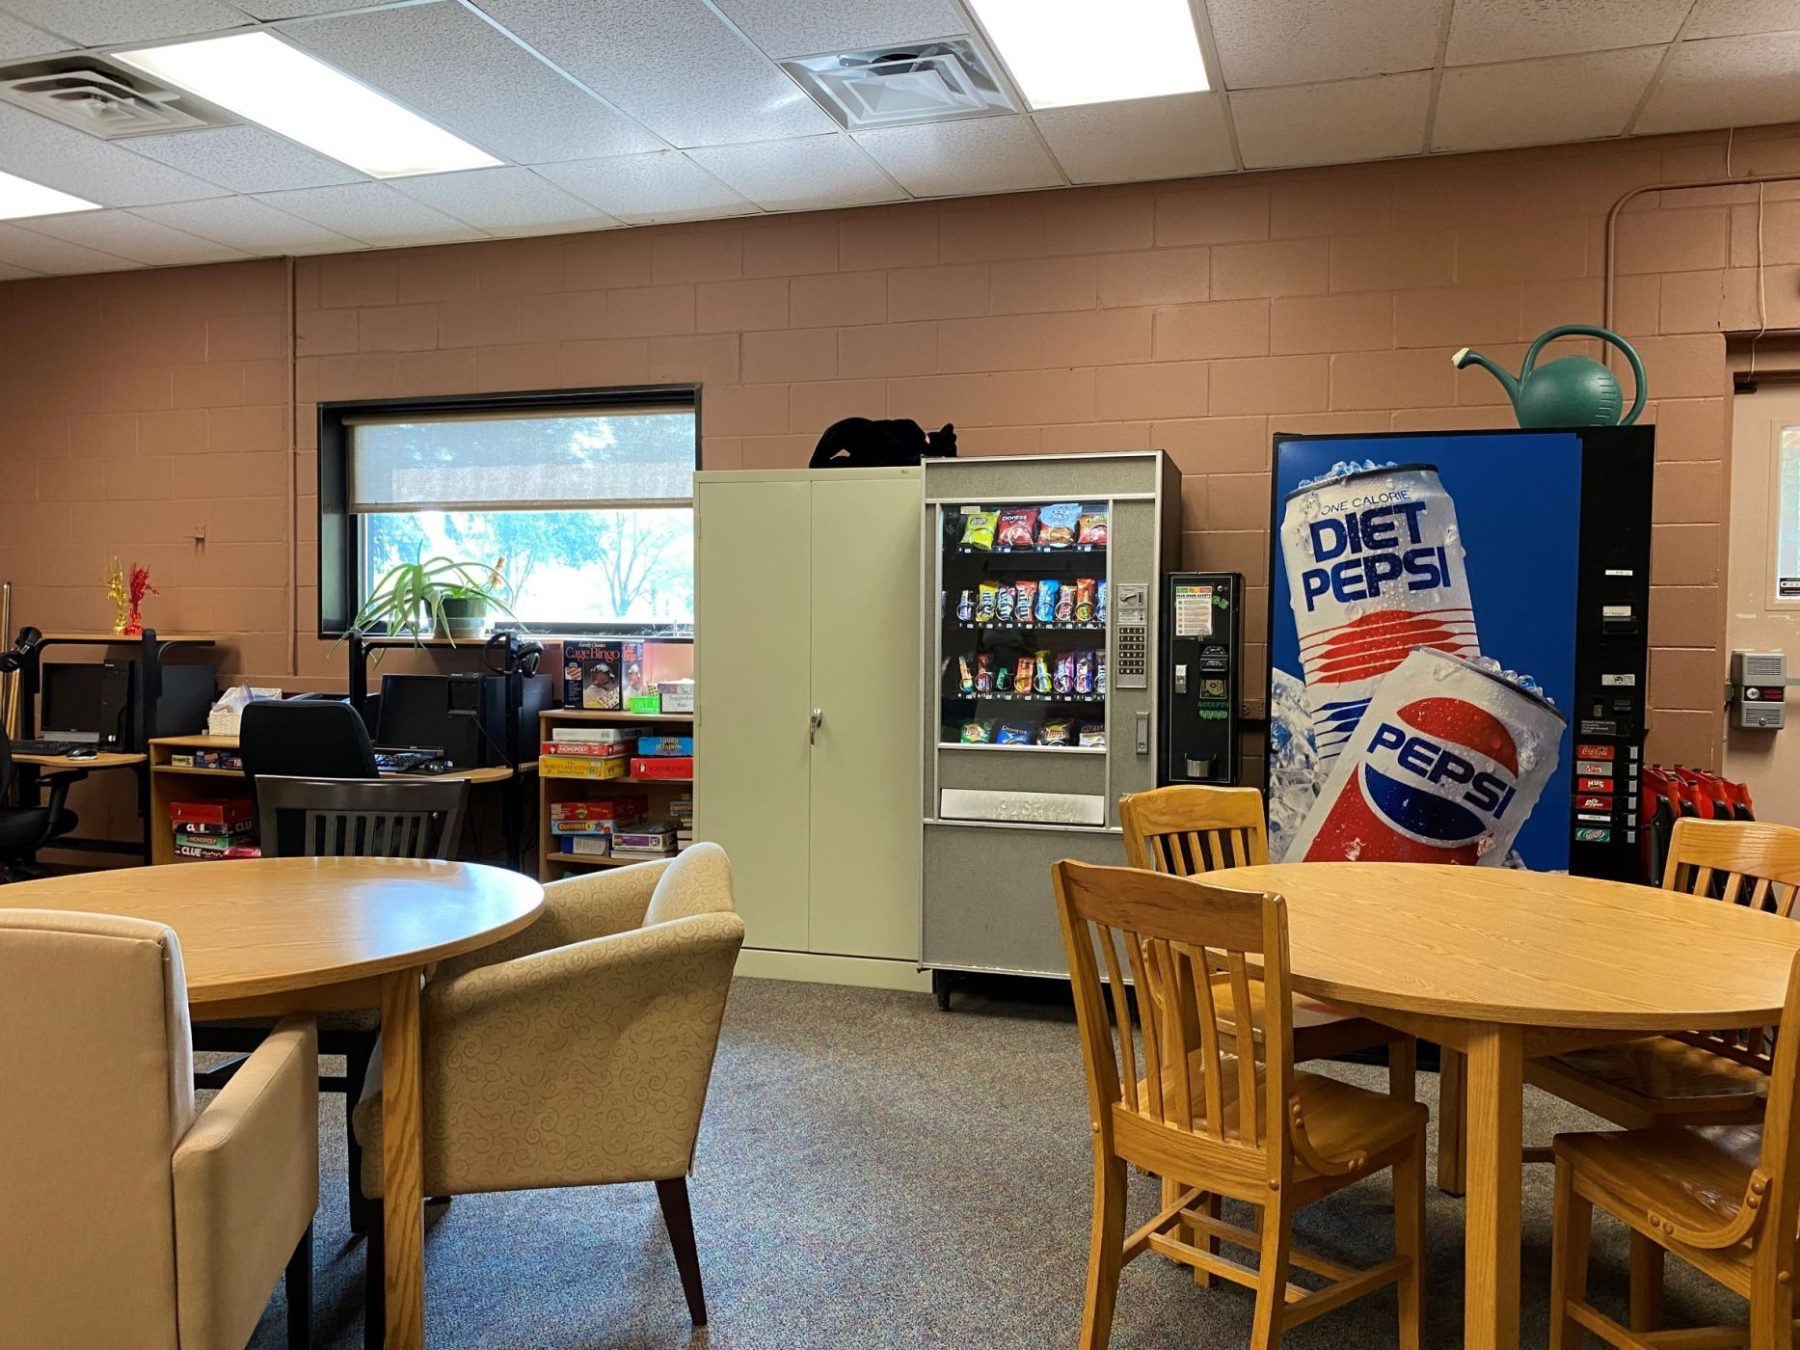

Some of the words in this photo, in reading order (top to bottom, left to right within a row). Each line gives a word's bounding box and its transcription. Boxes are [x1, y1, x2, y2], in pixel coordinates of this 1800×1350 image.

[1321, 503, 1348, 516] ONE
[1352, 490, 1411, 509] CALORIE
[1002, 514, 1027, 522] Doritos
[1309, 501, 1427, 563] DIET
[1302, 546, 1451, 612] PEPSI
[565, 646, 590, 662] Cage
[590, 647, 621, 662] Bingo
[1001, 724, 1028, 736] Doritos
[1366, 723, 1517, 820] PEPSI
[181, 846, 202, 857] CLUE
